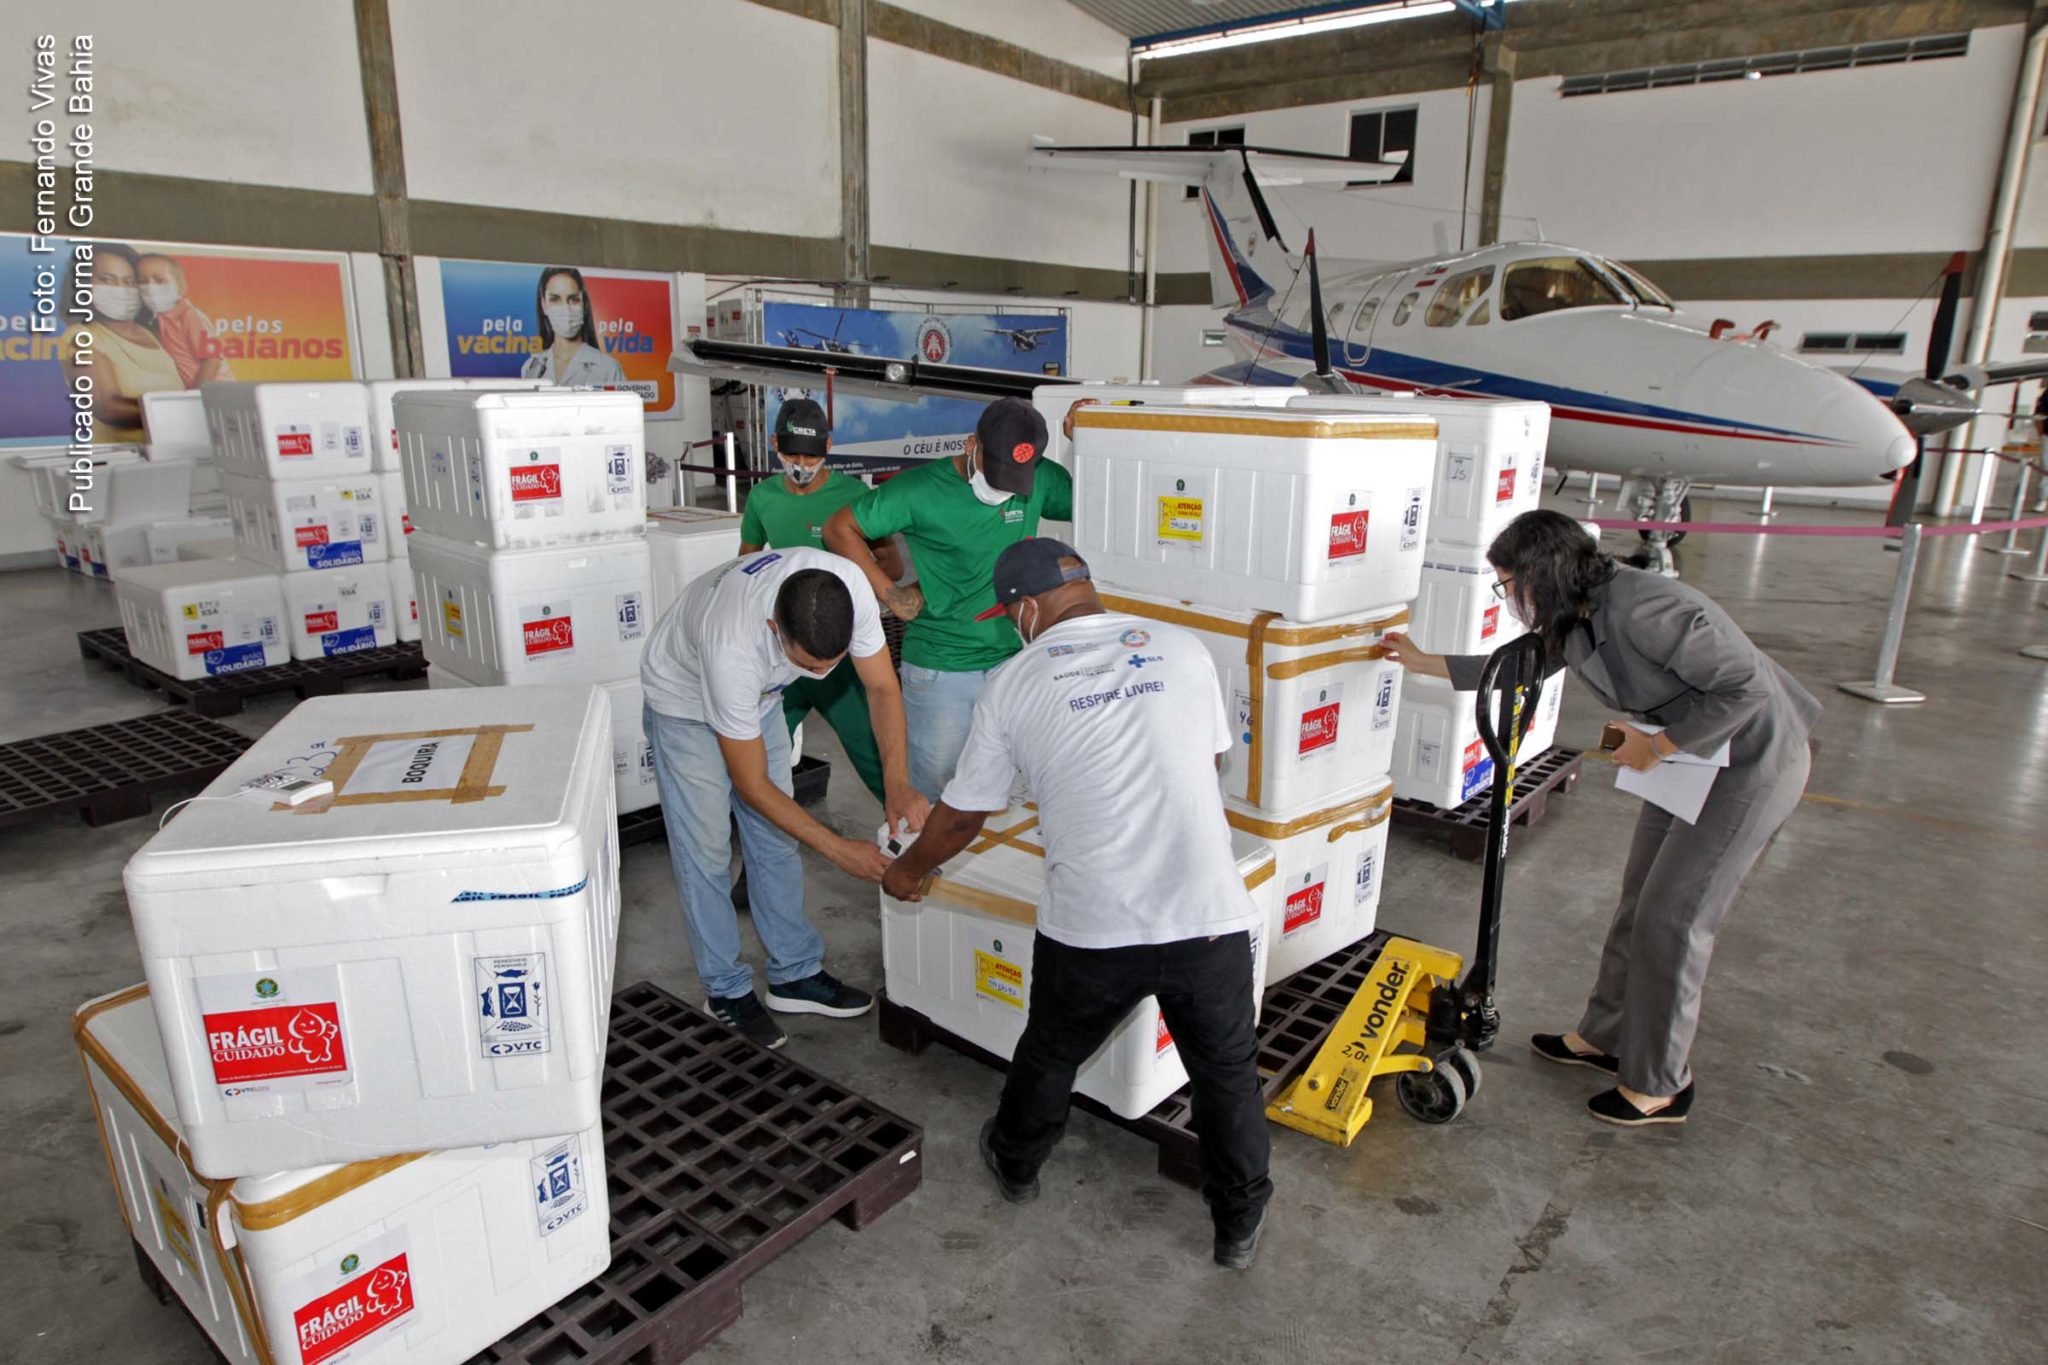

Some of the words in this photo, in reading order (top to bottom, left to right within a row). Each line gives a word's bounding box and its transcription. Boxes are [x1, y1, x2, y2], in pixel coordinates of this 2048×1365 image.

[215, 315, 284, 336] pelos
[482, 316, 523, 335] pela
[598, 318, 635, 334] pela
[200, 329, 343, 359] baianos
[457, 331, 544, 354] vacina
[604, 332, 654, 353] vida
[616, 384, 651, 392] GOVERNO
[903, 444, 911, 455] O
[913, 439, 933, 454] CÉU
[935, 439, 941, 453] É
[944, 439, 968, 451] NOSS
[511, 472, 540, 484] FRÁGIL
[316, 556, 362, 569] SOLIDÁRIO
[525, 628, 551, 639] FRÁGIL
[332, 641, 376, 655] SOLIDÁRIO
[215, 658, 264, 674] SOLIDÁRIO
[1070, 688, 1123, 712] RESPIRE
[1124, 681, 1165, 698] LIVRE!
[402, 741, 440, 784] BOQUIRA
[1360, 961, 1408, 1038] vonder
[209, 1025, 284, 1051] FRÁGIL
[213, 1045, 286, 1063] CUIDADO
[1341, 1044, 1369, 1063] 2,0t
[300, 1295, 364, 1342] FRÁGIL
[302, 1311, 365, 1351] CUIDADO
